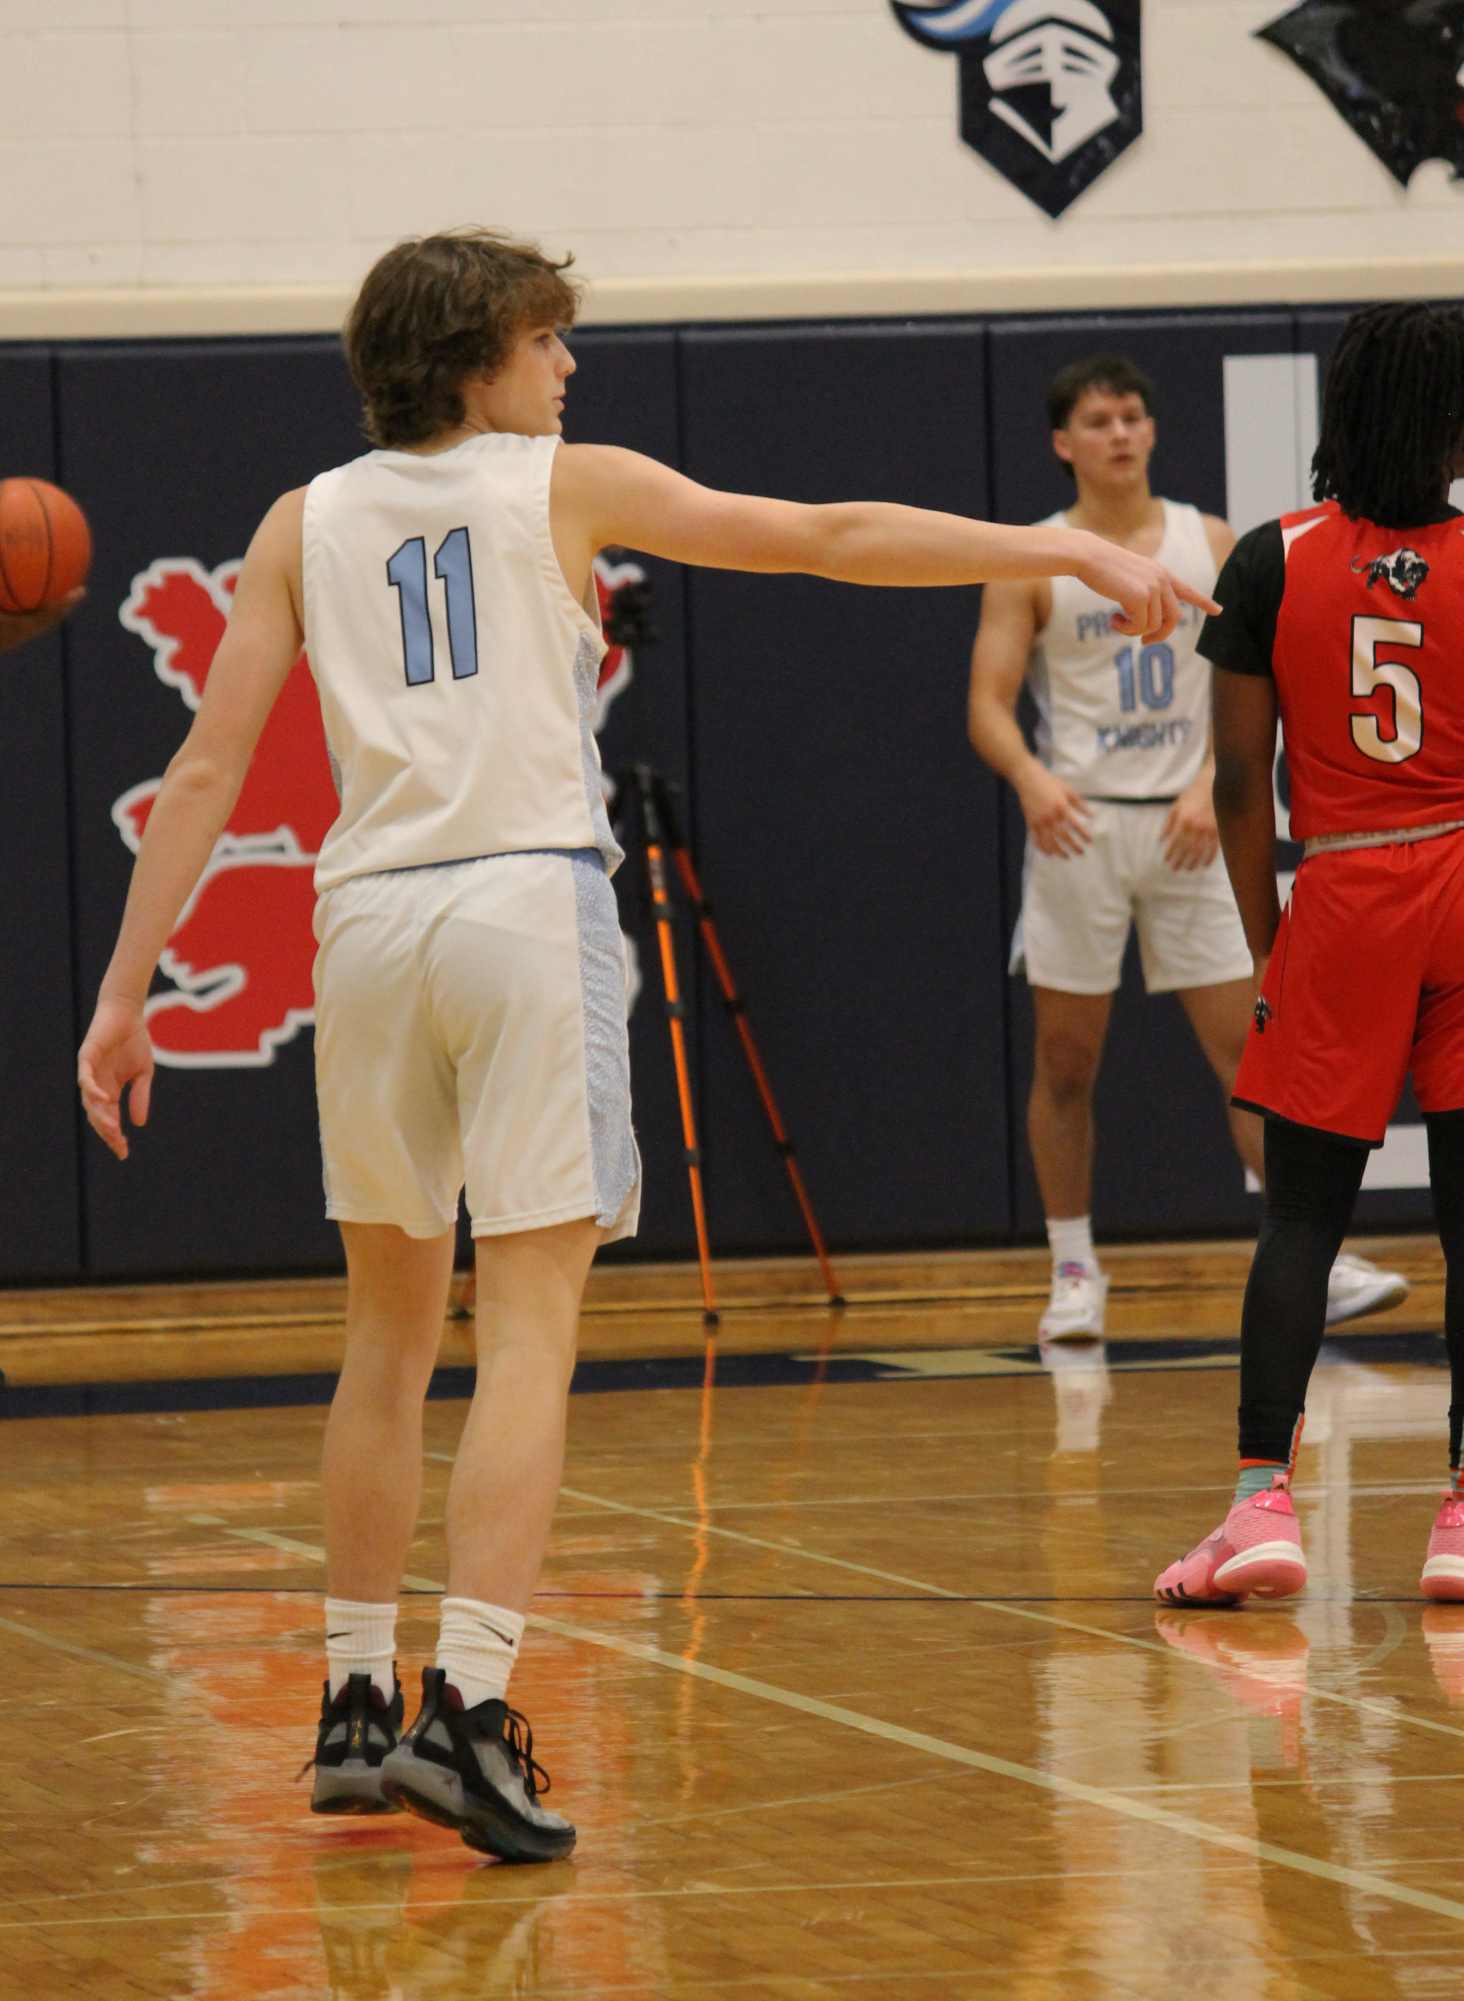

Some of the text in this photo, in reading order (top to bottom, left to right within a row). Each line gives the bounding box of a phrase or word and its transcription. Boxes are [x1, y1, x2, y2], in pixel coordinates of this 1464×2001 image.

[386, 526, 478, 687] 11
[1114, 642, 1176, 714] 10
[1349, 614, 1424, 764] 5
